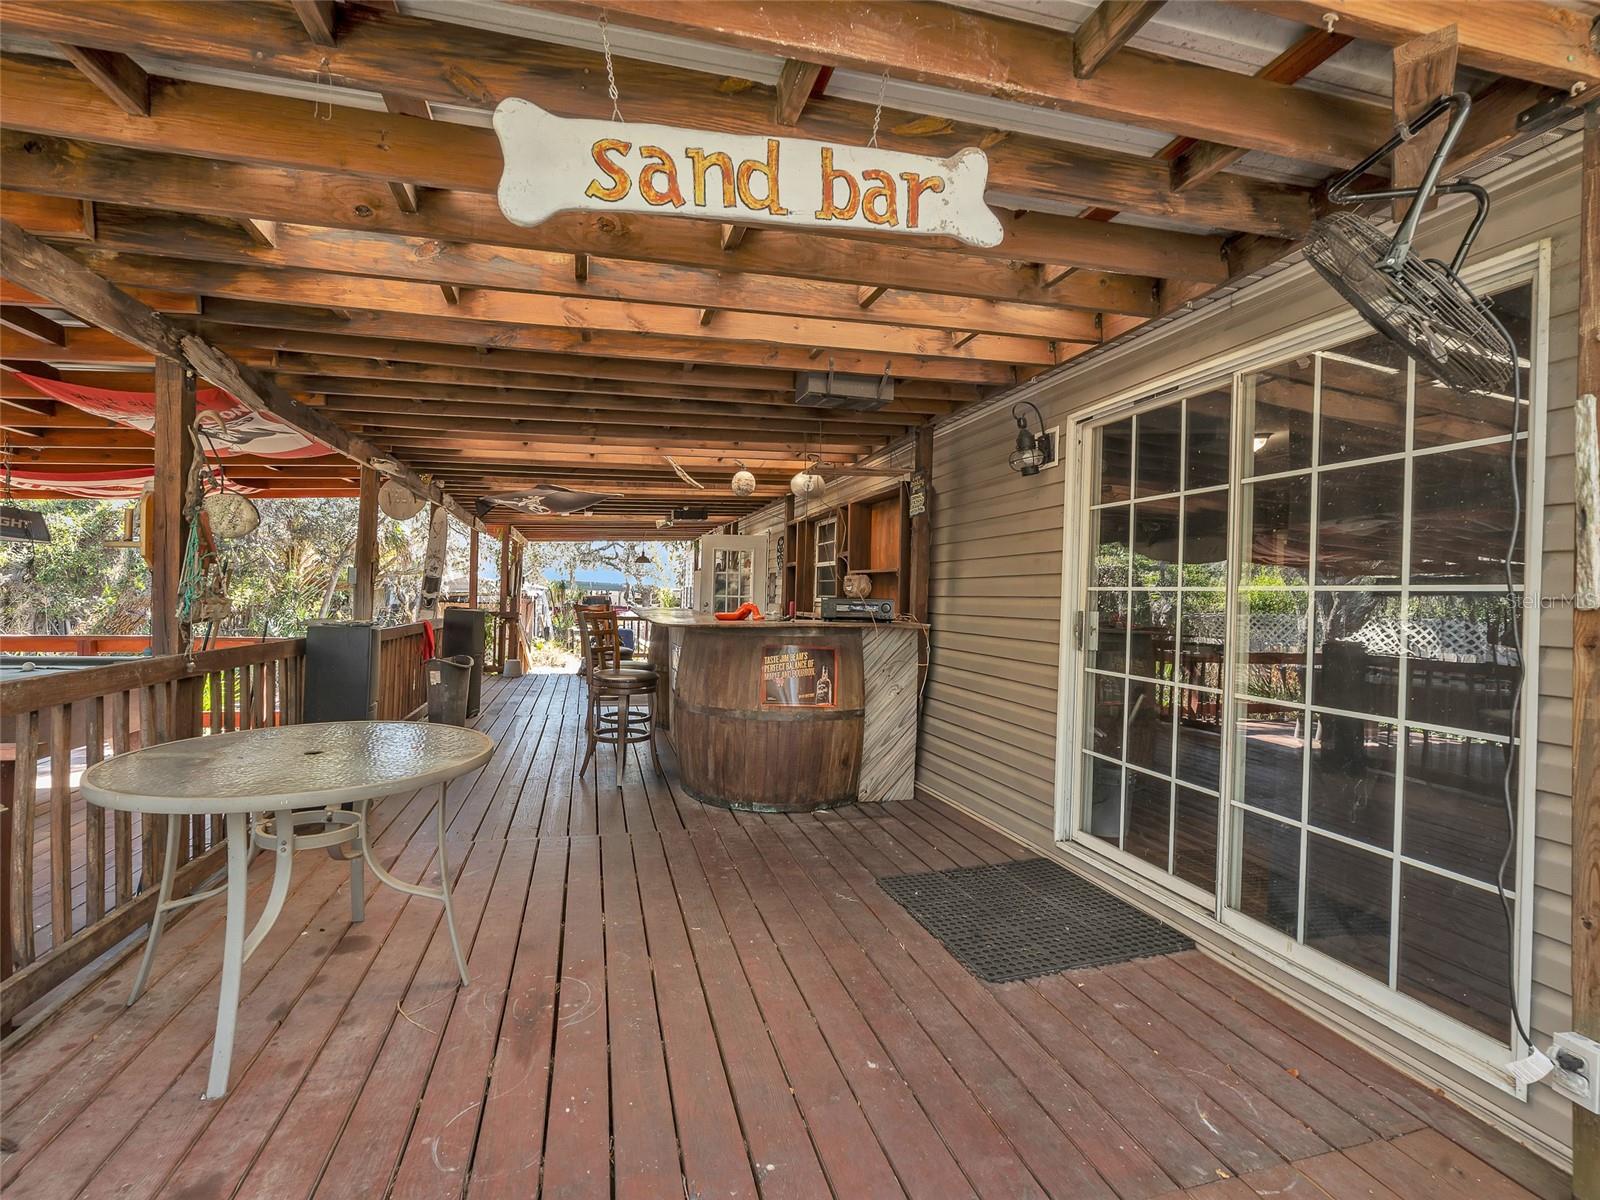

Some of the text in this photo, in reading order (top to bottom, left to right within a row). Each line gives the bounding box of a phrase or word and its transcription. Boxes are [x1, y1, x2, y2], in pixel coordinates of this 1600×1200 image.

[584, 138, 946, 229] sand bar
[764, 655, 780, 664] TASTE
[764, 659, 815, 673] PERFECT BALANCE OF
